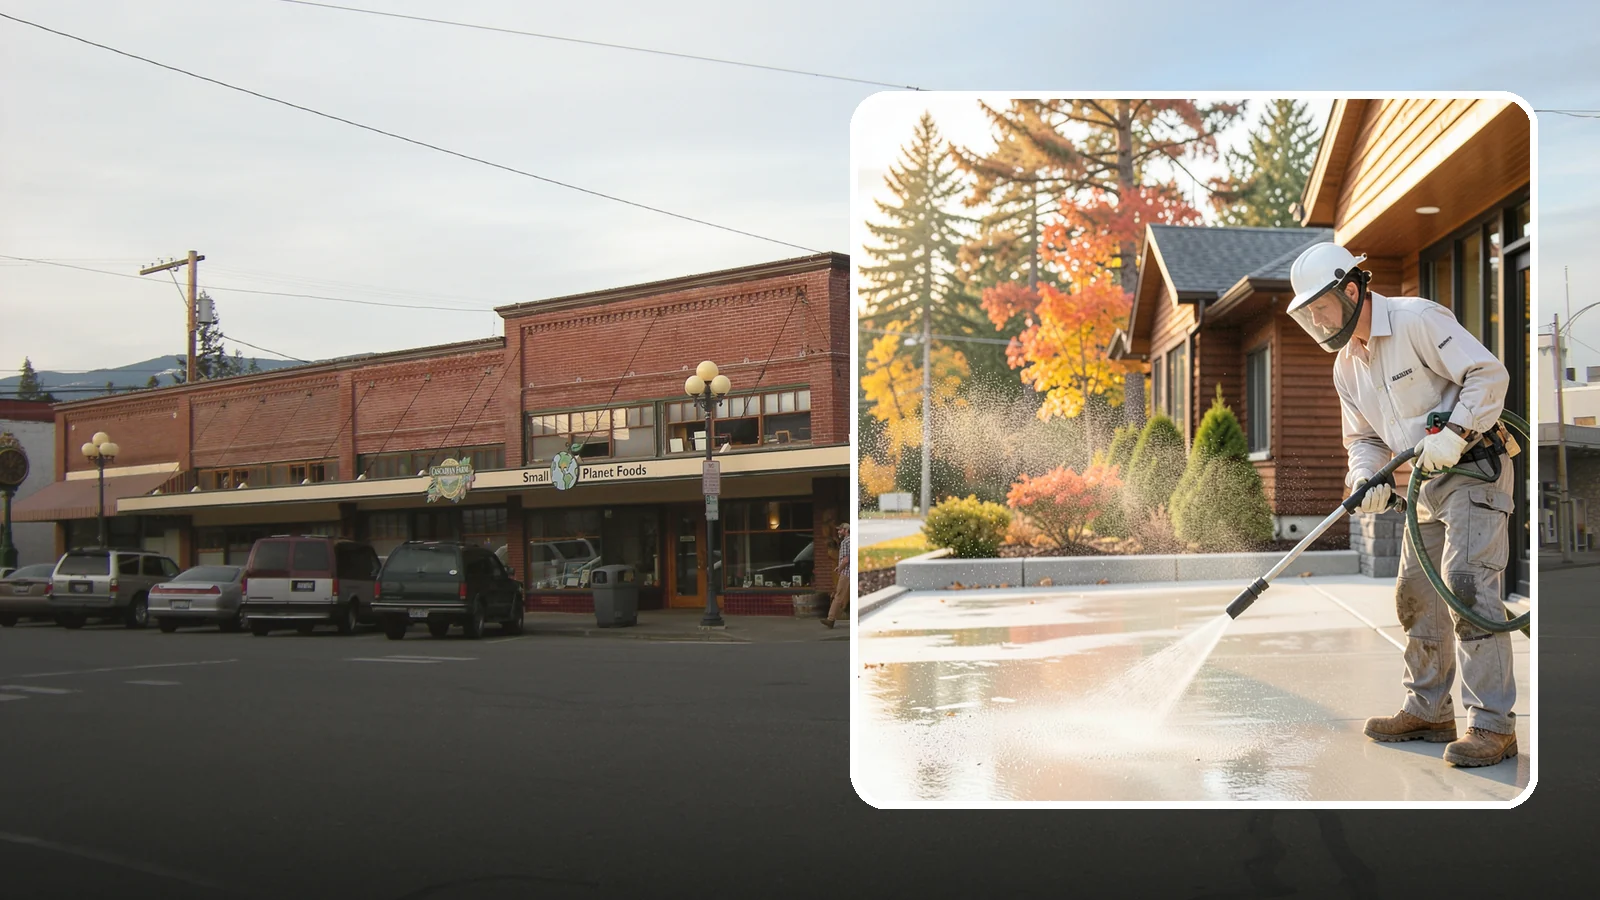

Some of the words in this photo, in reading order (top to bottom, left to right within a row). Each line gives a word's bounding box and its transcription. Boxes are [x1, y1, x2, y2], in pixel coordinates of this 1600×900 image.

[431, 467, 455, 476] CASCADIAN
[455, 465, 469, 475] FARM
[523, 471, 549, 482] Small
[583, 468, 614, 479] Planet
[617, 465, 647, 476] Foods
